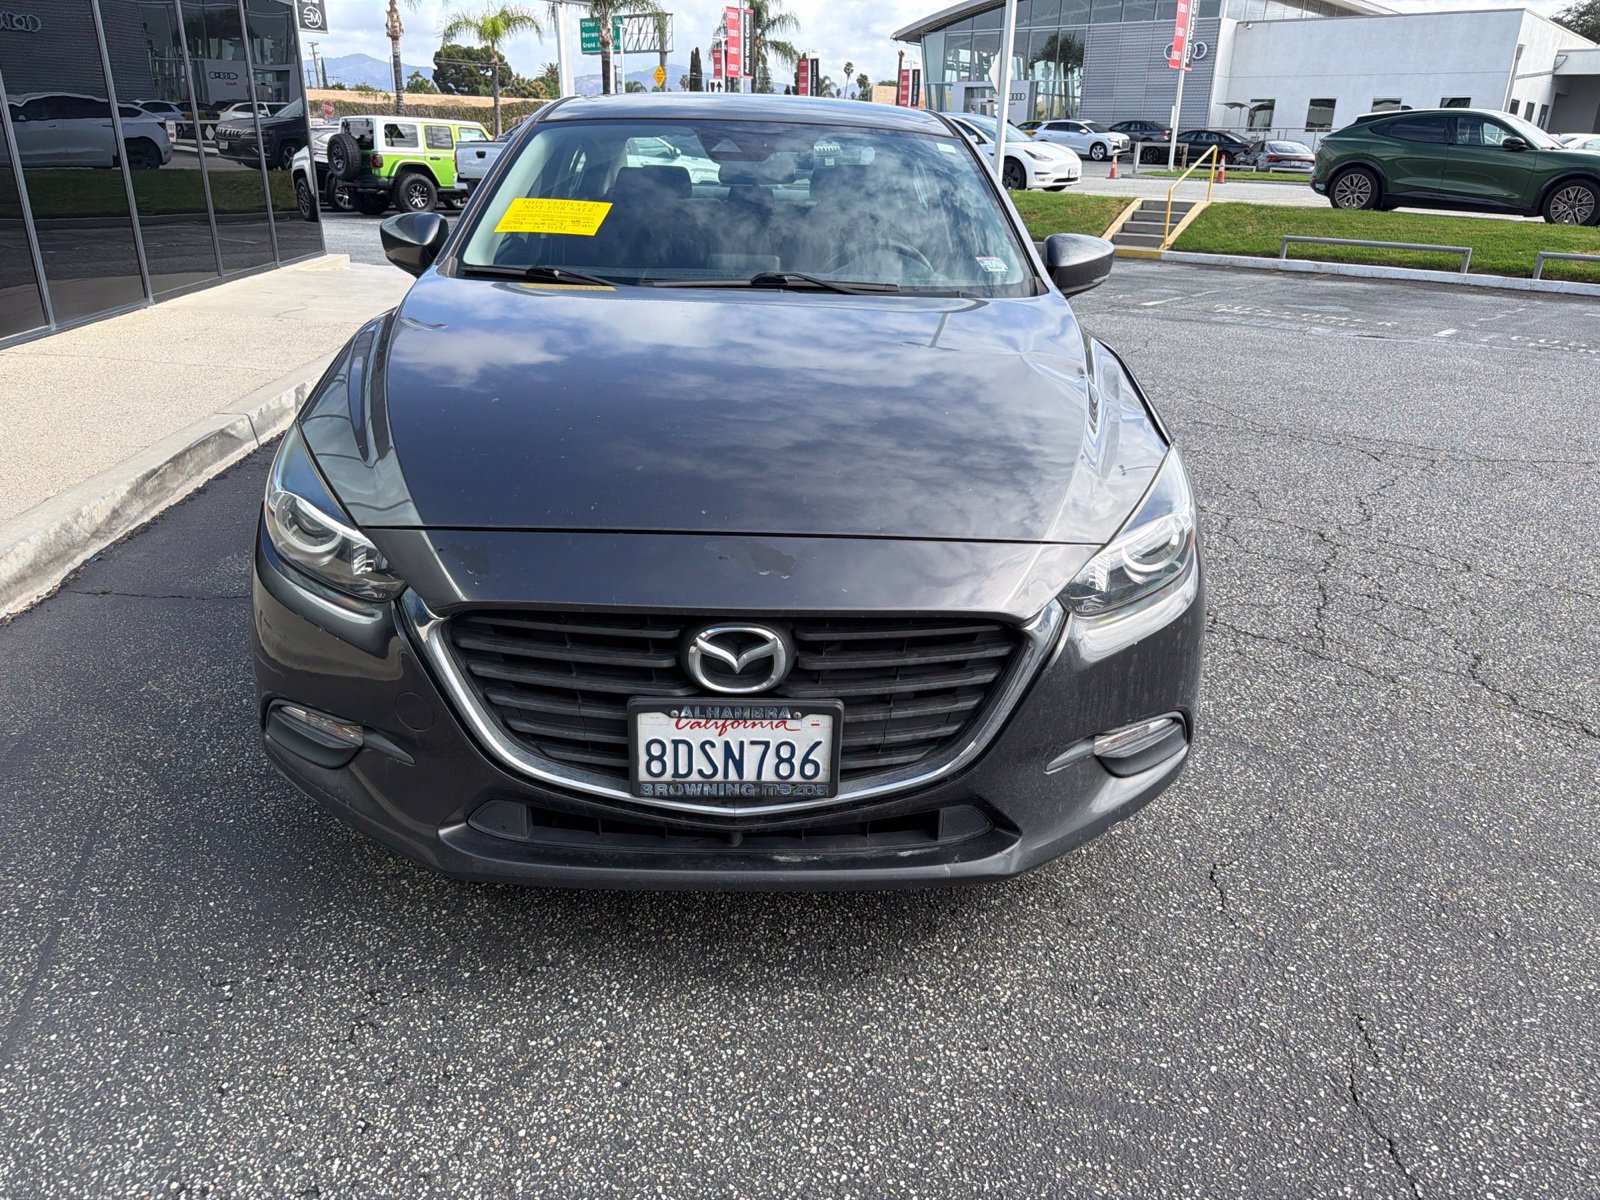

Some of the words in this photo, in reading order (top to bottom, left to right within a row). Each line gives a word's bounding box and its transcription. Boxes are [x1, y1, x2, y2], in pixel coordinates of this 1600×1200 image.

[680, 706, 791, 719] ALHAMBRA
[675, 717, 801, 736] California
[645, 738, 823, 780] 8DSN786
[640, 783, 755, 797] BROWNING
